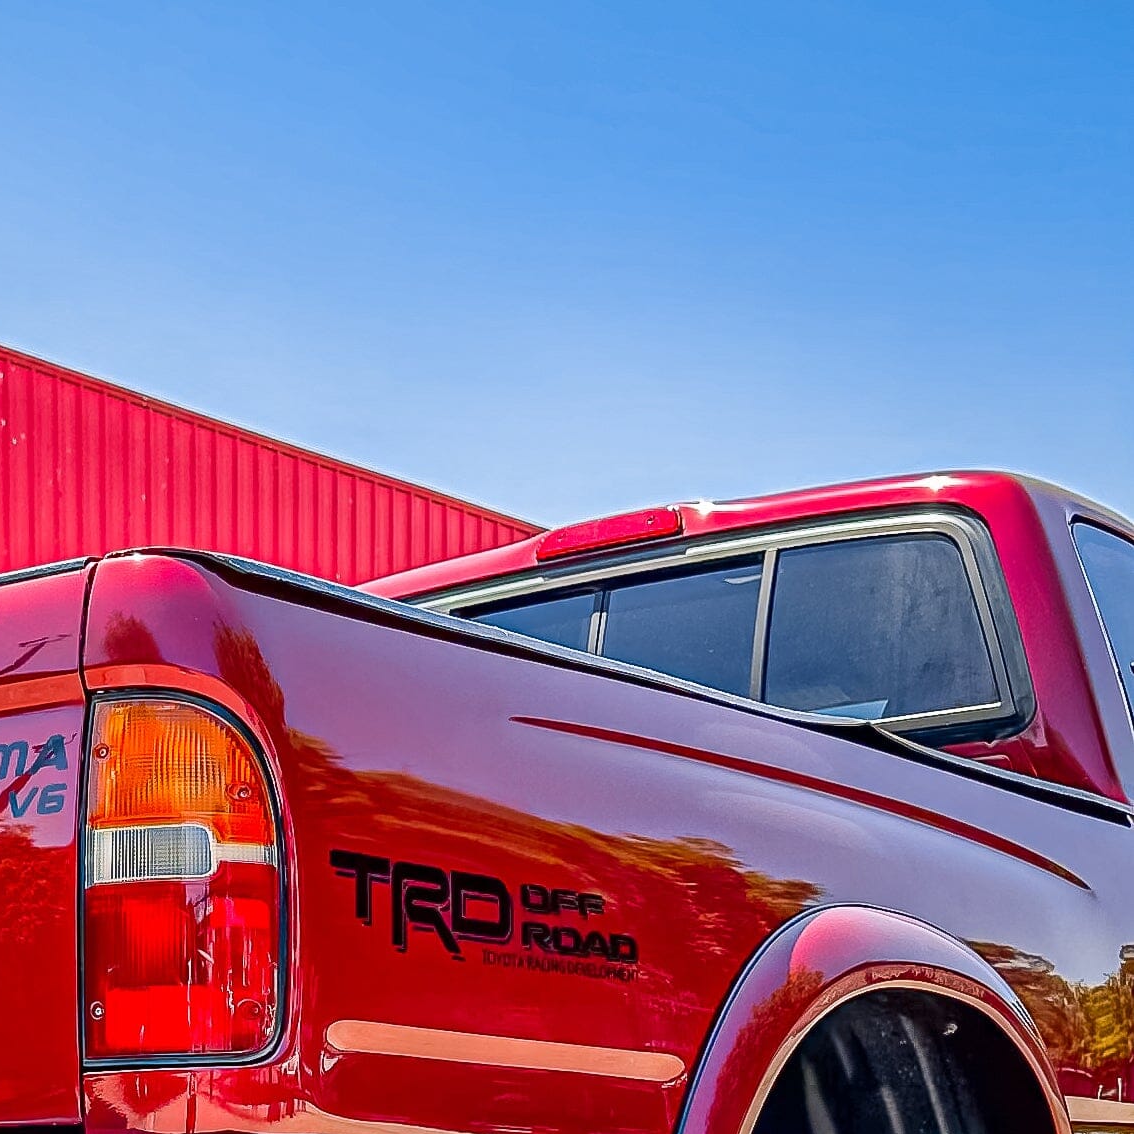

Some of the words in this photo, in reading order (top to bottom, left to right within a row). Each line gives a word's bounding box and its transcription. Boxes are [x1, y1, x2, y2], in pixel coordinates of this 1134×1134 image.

[8, 783, 68, 818] V6
[329, 848, 514, 961] TRD
[520, 884, 604, 920] OFF
[521, 921, 639, 963] ROAD
